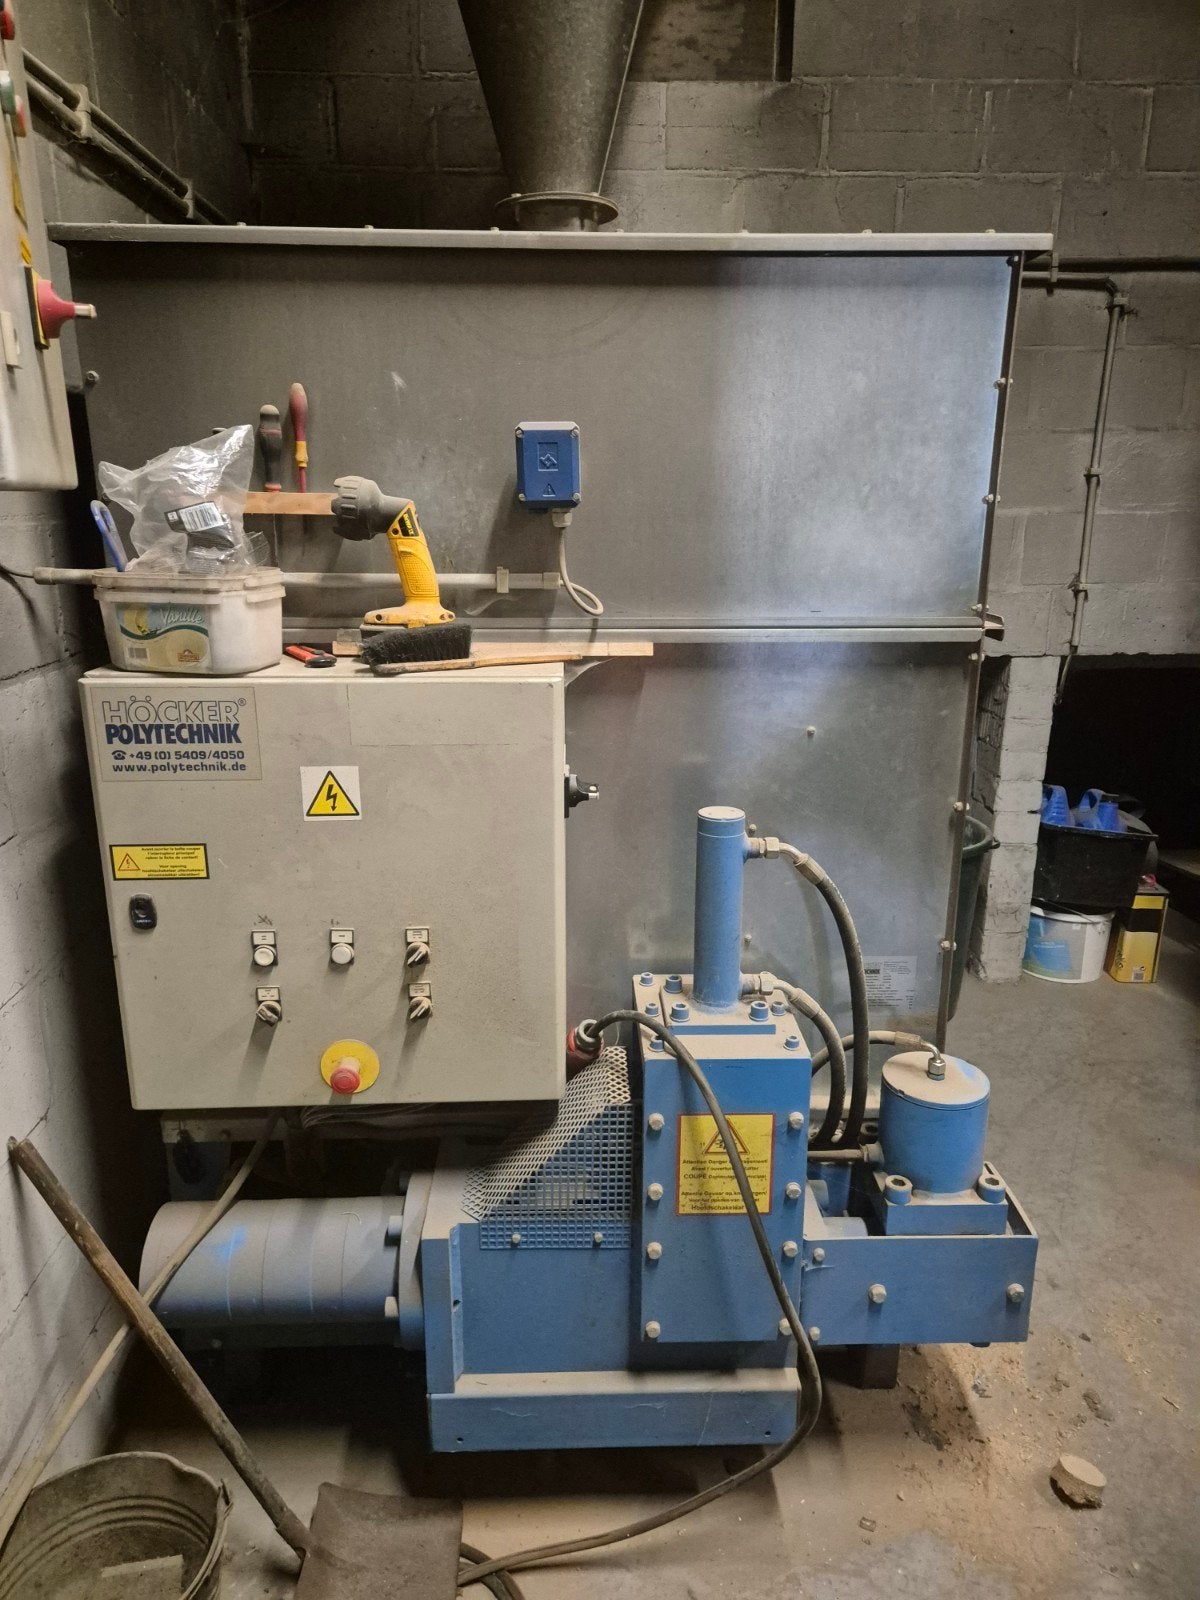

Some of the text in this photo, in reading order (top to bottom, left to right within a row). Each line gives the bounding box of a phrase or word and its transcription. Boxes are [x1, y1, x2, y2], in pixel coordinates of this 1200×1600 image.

[160, 605, 204, 626] Vanille
[104, 723, 242, 744] POLYTECHNIK
[129, 750, 245, 760] +49 (0) 5409/4050
[112, 761, 247, 774] www.polytechnik.de
